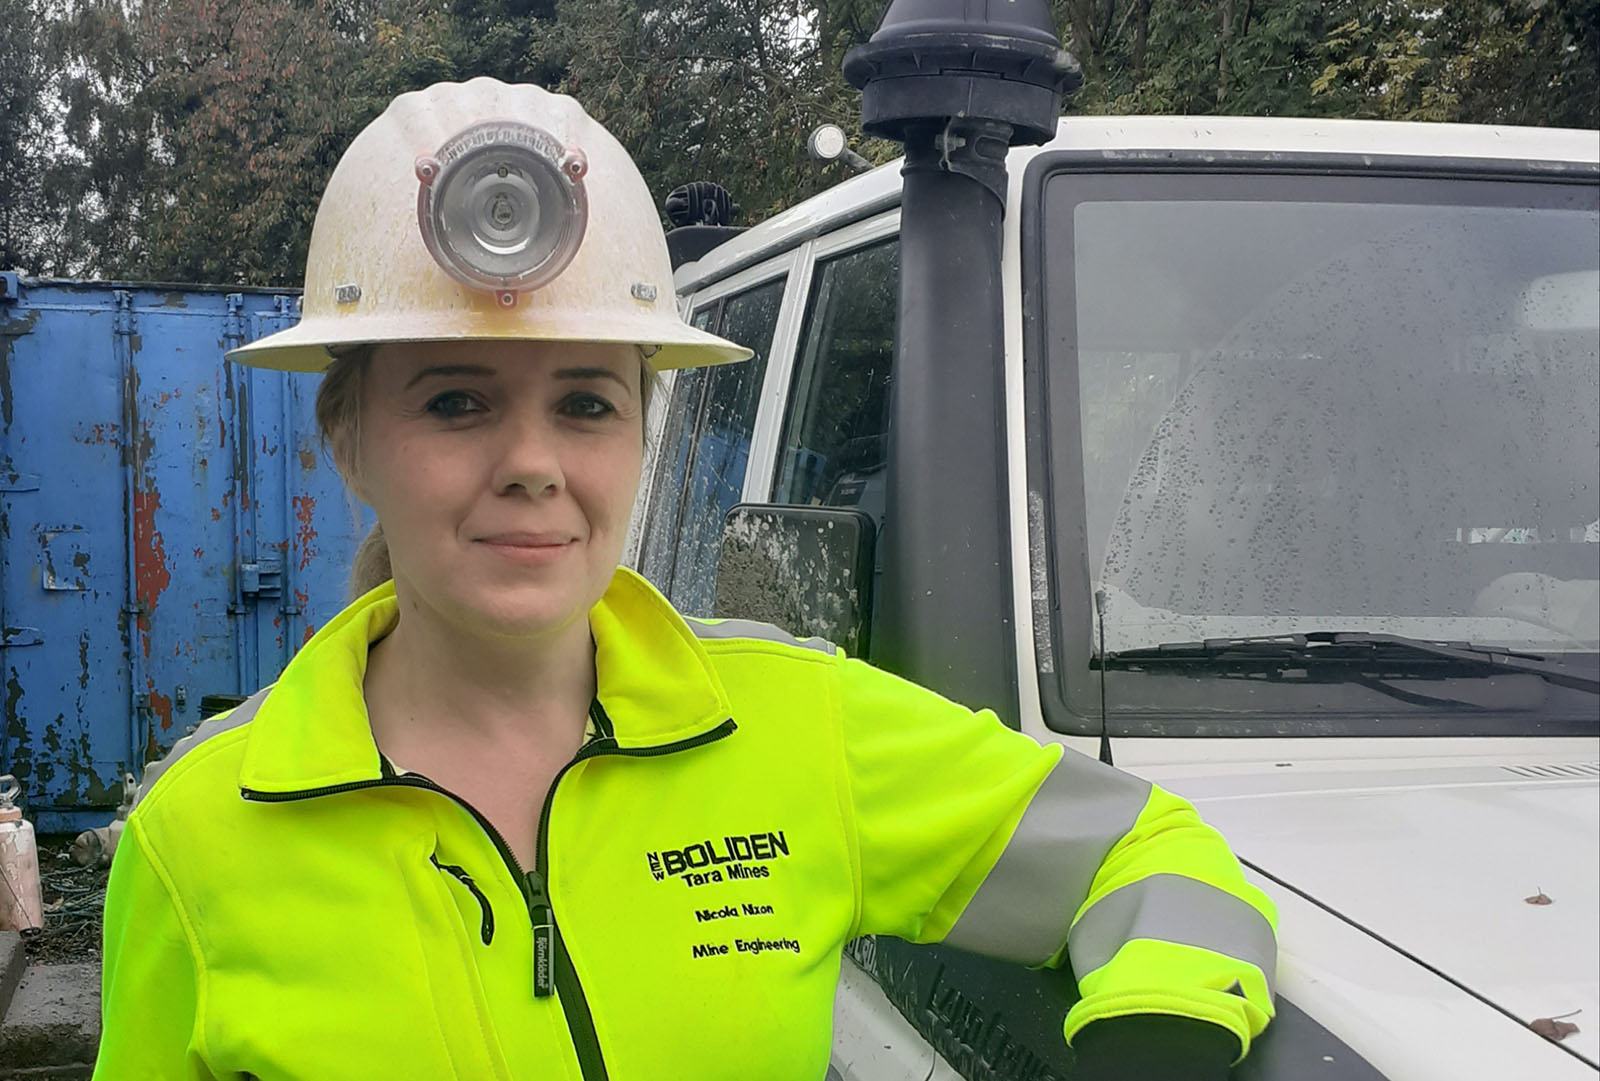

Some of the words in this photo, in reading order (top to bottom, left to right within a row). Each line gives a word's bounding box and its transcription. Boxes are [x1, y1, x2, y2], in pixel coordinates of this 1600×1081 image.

[661, 831, 790, 876] BOLIDEN
[647, 851, 665, 881] NEW
[681, 870, 723, 887] Tara
[726, 863, 770, 880] Mines
[695, 906, 739, 922] Nicola
[741, 904, 774, 916] Nixon
[692, 943, 729, 958] Mine
[735, 938, 801, 955] Engineering
